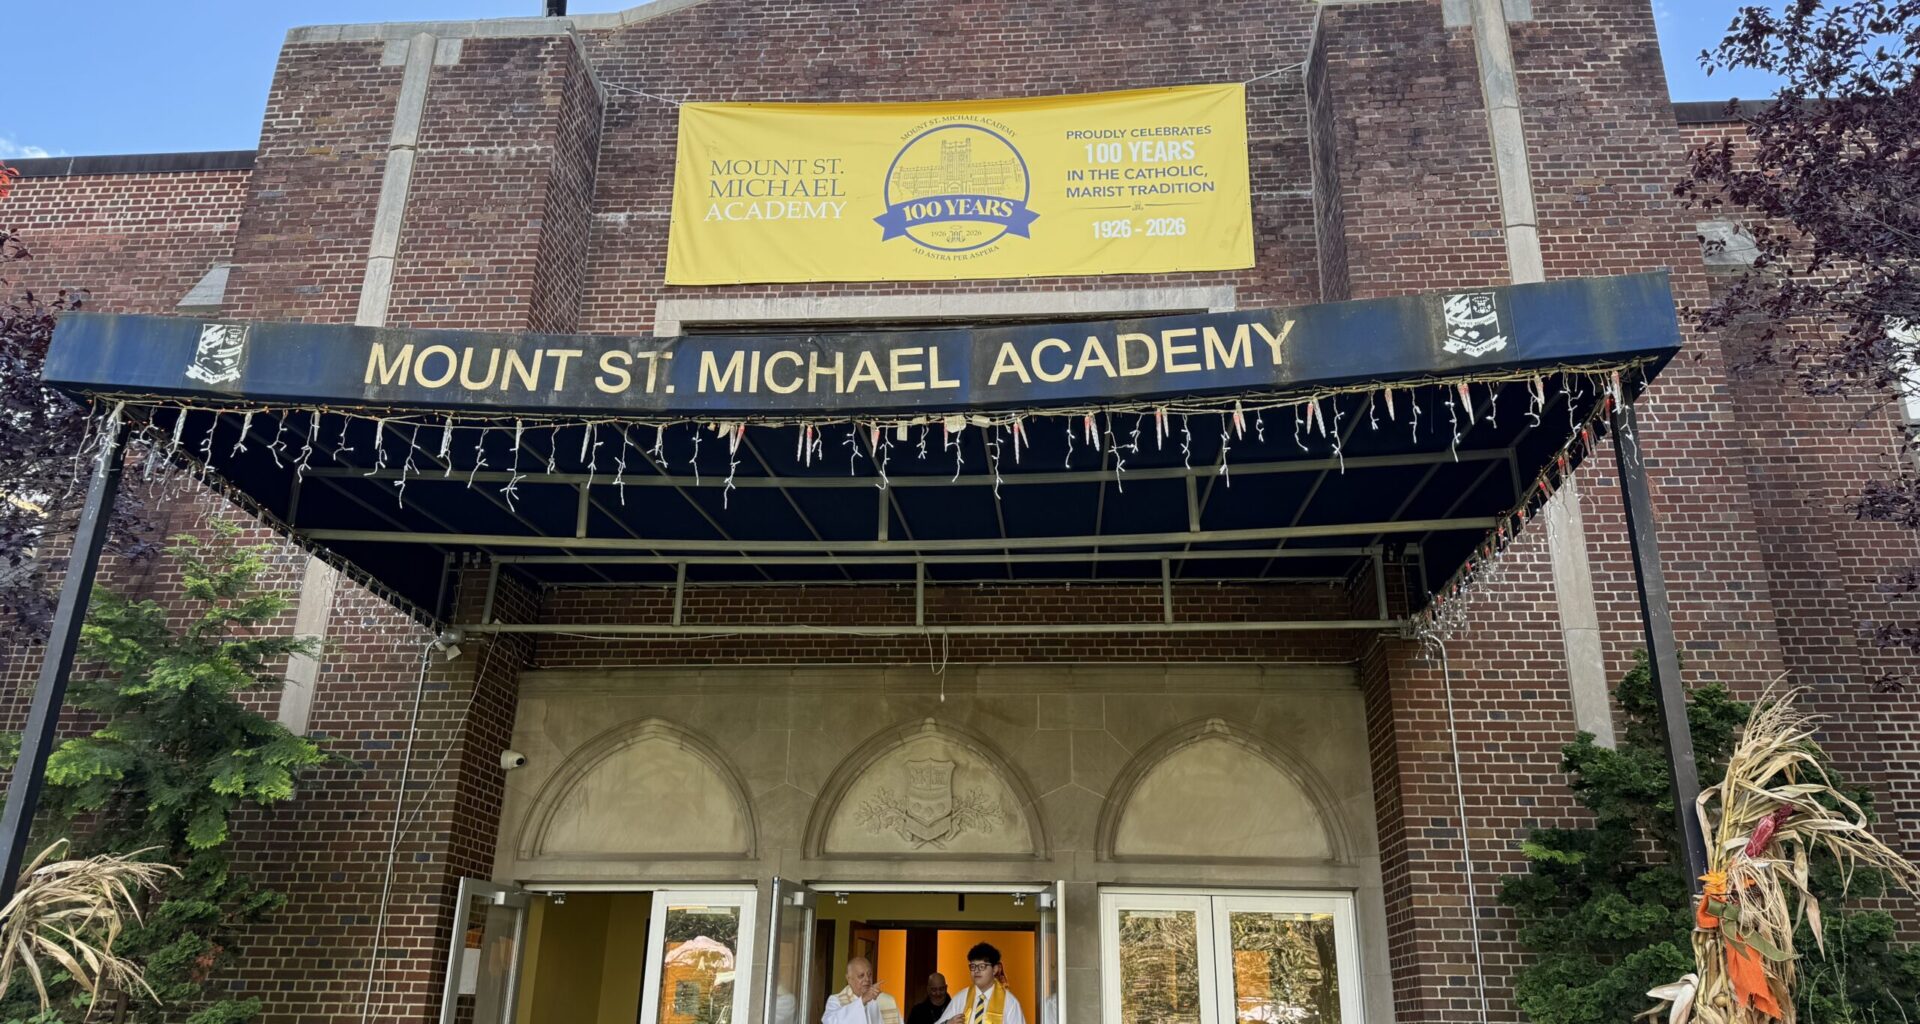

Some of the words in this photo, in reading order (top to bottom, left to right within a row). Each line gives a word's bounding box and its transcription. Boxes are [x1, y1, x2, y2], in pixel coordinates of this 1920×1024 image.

[900, 122, 928, 141] MOUNT
[942, 114, 979, 122] MICHAEL
[980, 116, 1017, 138] ACADEMY
[1066, 129, 1127, 140] PROUDLY
[1130, 125, 1212, 138] CELEBRATES
[1085, 142, 1122, 164] 100
[1127, 140, 1195, 163] YEARS
[710, 159, 808, 176] MOUNT
[812, 158, 845, 175] ST.
[1067, 169, 1084, 181] IN
[1088, 168, 1120, 181] THE
[1124, 165, 1208, 180] CATHOLIC,
[708, 178, 846, 198] MICHAEL
[1066, 185, 1125, 198] MARIST
[1128, 181, 1215, 196] TRADITION
[703, 201, 848, 222] ACADEMY
[902, 200, 942, 222] 100
[944, 198, 1014, 218] YEARS
[1092, 218, 1132, 240] 1926
[1145, 217, 1186, 237] 2026
[912, 247, 925, 256] AD
[926, 251, 951, 262] ASTRA
[969, 245, 1000, 260] ASPERA
[363, 342, 583, 392] MOUNT
[594, 349, 675, 394] ST.
[697, 346, 960, 394] MICHAEL
[988, 319, 1296, 386] ACADEMY
